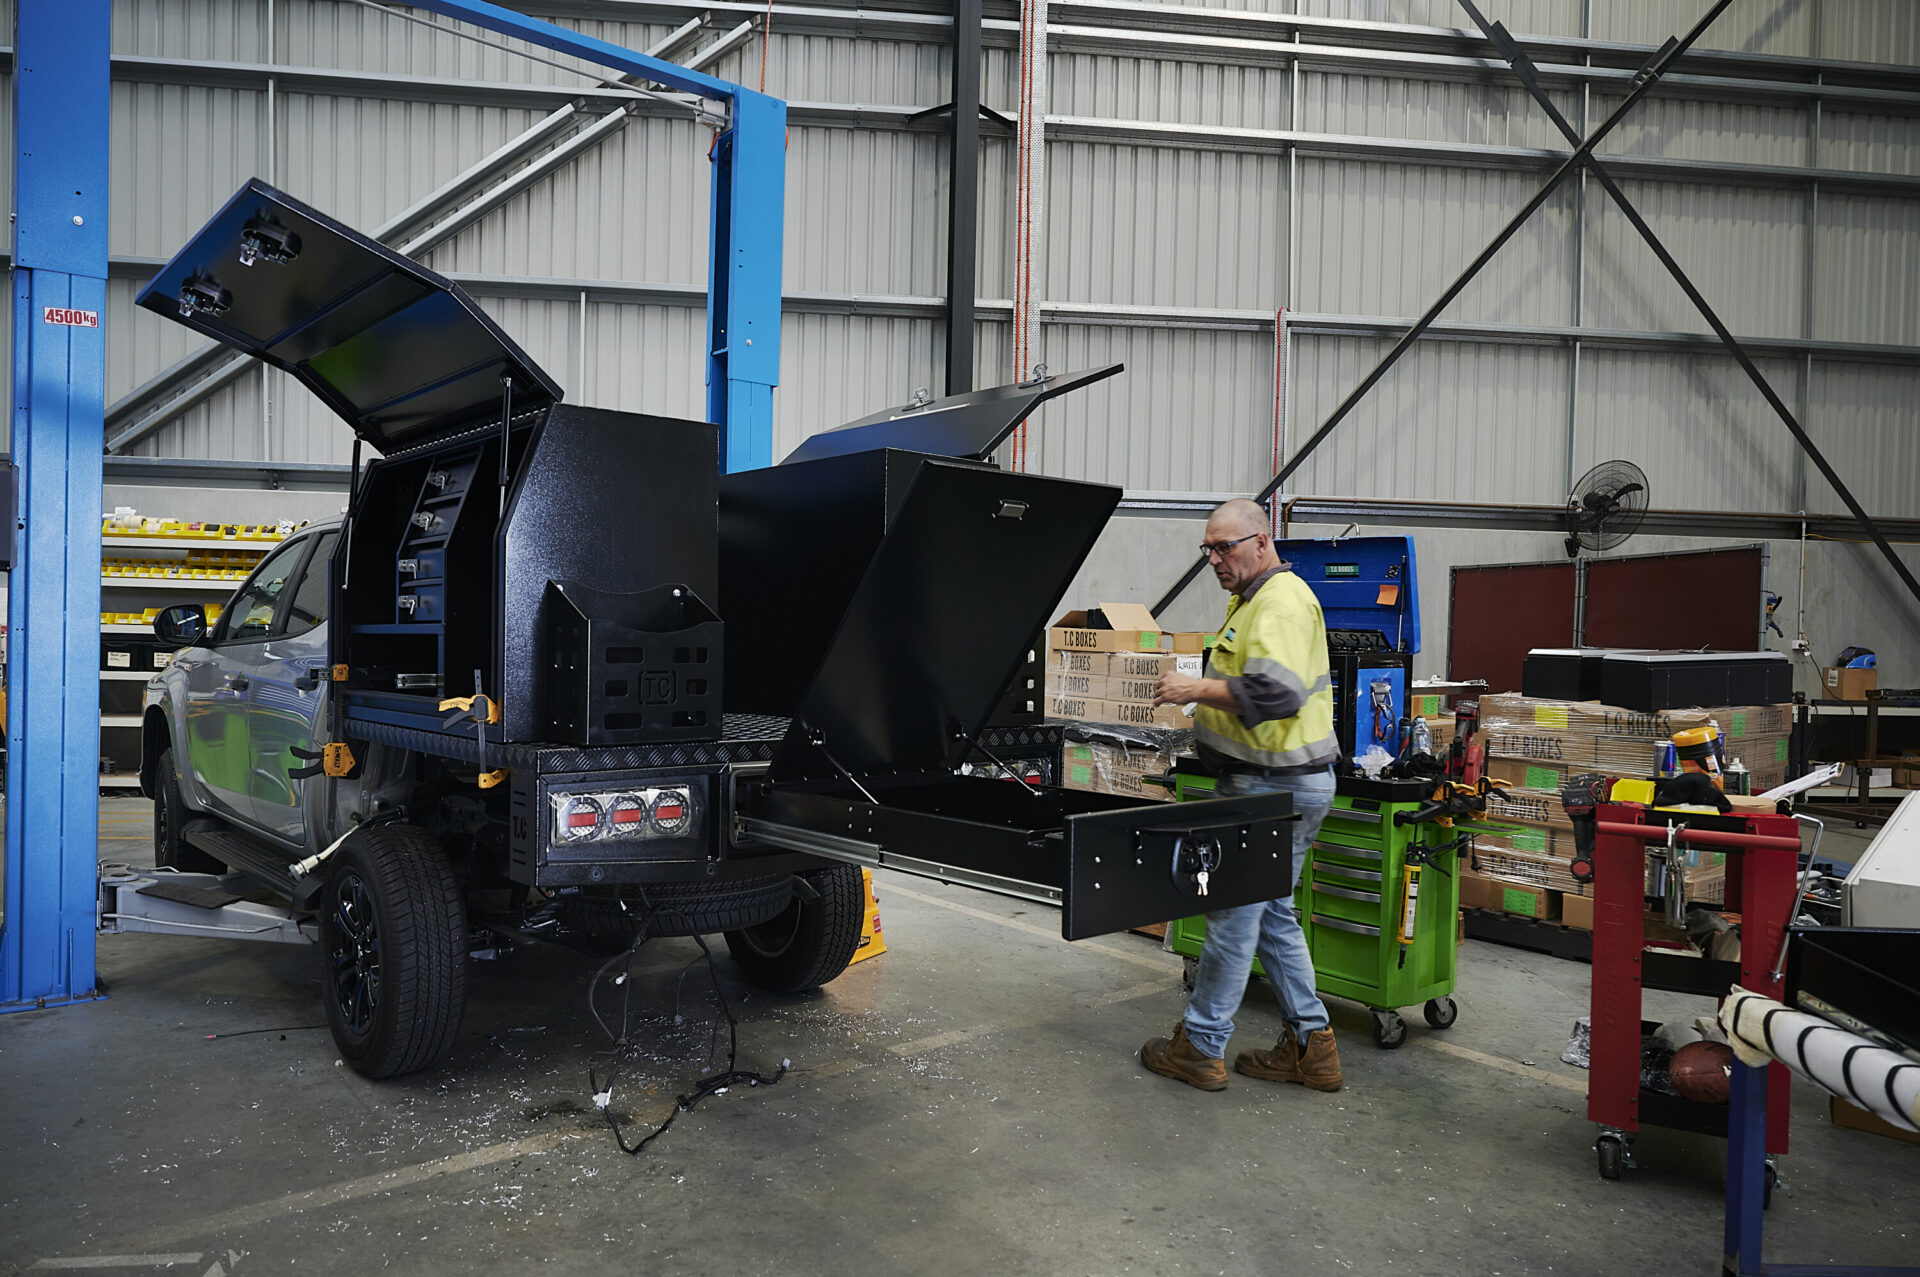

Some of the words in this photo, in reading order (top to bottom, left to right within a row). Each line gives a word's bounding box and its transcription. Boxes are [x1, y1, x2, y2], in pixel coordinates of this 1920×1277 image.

[46, 309, 96, 326] 4500kg
[1064, 631, 1074, 646] T.C
[1076, 631, 1097, 648] BOXES
[1070, 654, 1091, 672] BOXES
[1124, 658, 1135, 675] T.C
[1136, 659, 1159, 676] BOXES
[645, 677, 671, 699] TC
[1068, 676, 1090, 694] BOXES
[1122, 680, 1133, 698] T.C
[1064, 700, 1086, 718] BOXES
[1118, 704, 1130, 722] T.C
[1130, 706, 1155, 723] BOXES
[1524, 737, 1563, 760] BOXES
[512, 816, 527, 840] T.C
